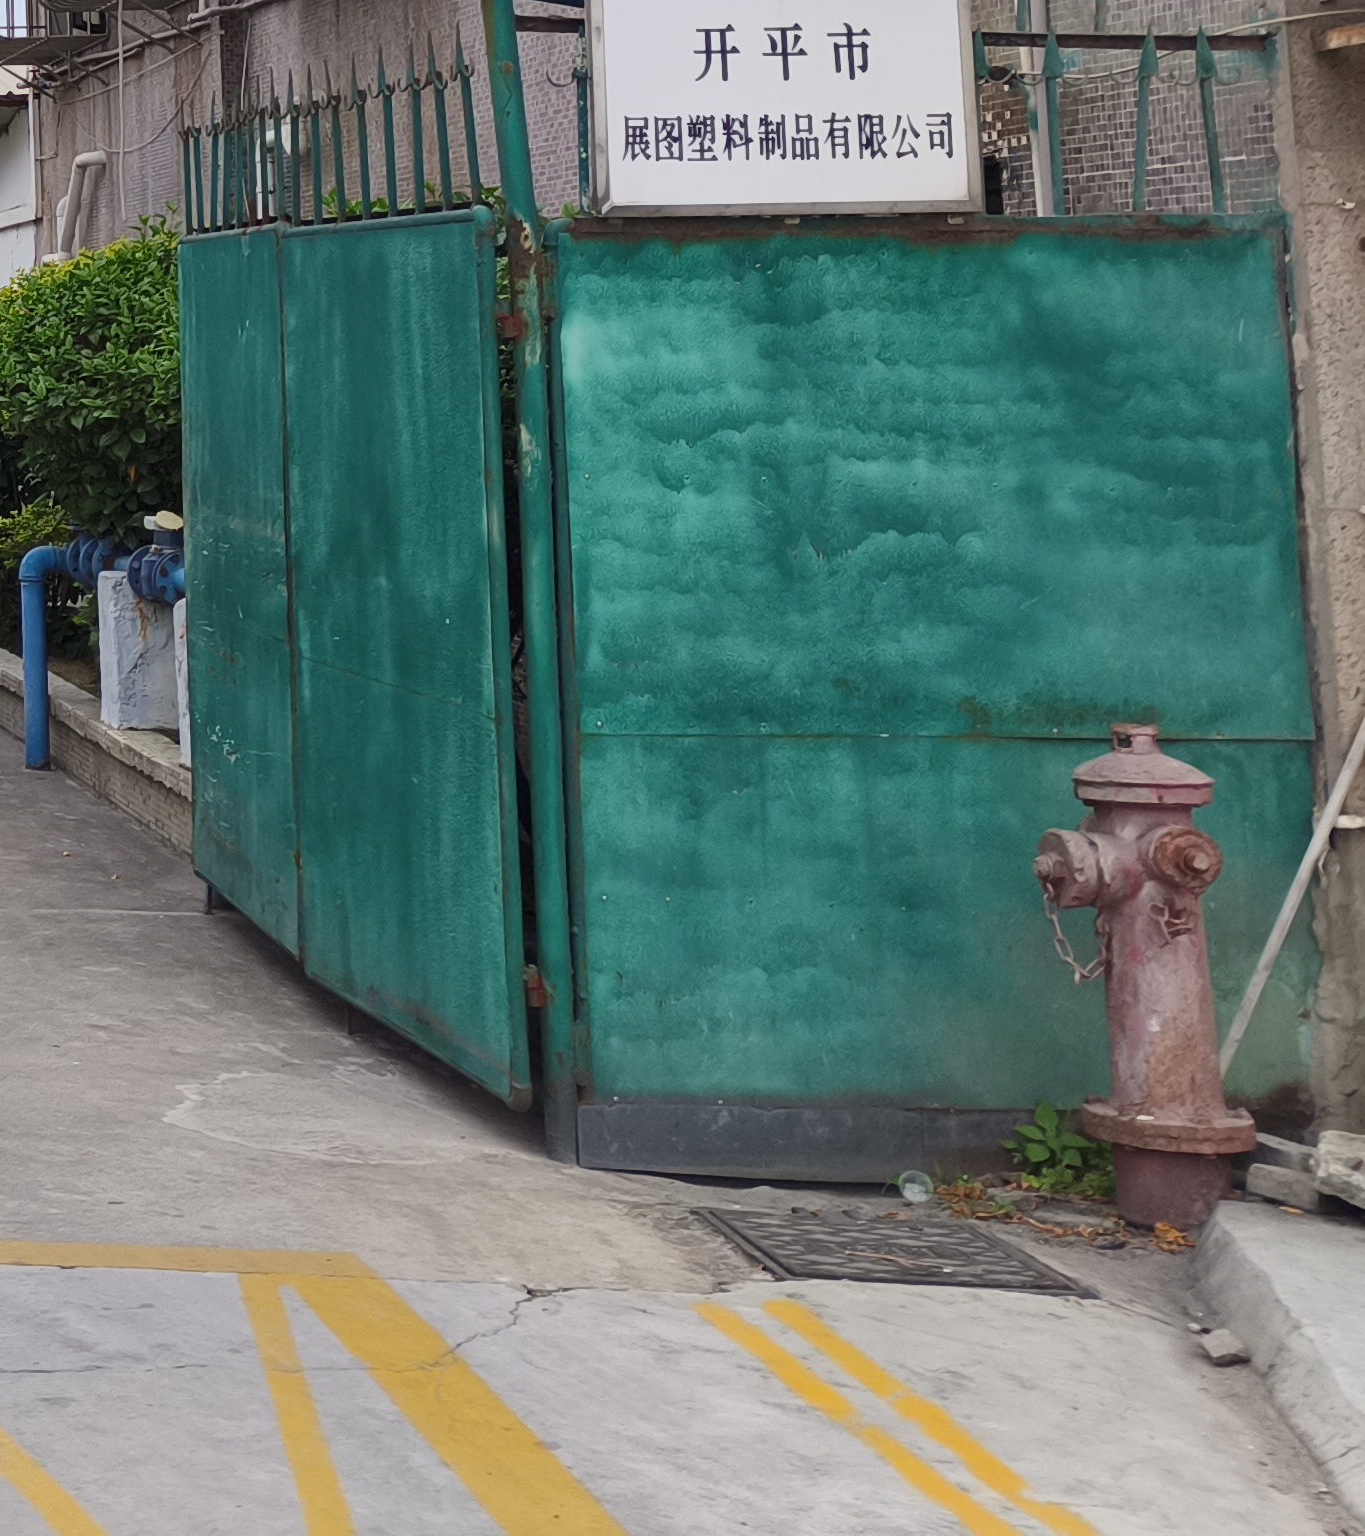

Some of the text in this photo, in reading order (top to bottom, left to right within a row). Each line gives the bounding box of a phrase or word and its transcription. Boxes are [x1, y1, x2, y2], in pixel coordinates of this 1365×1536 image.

[693, 22, 872, 82] 开平市
[622, 112, 954, 162] 展图塑料制品有限公司
